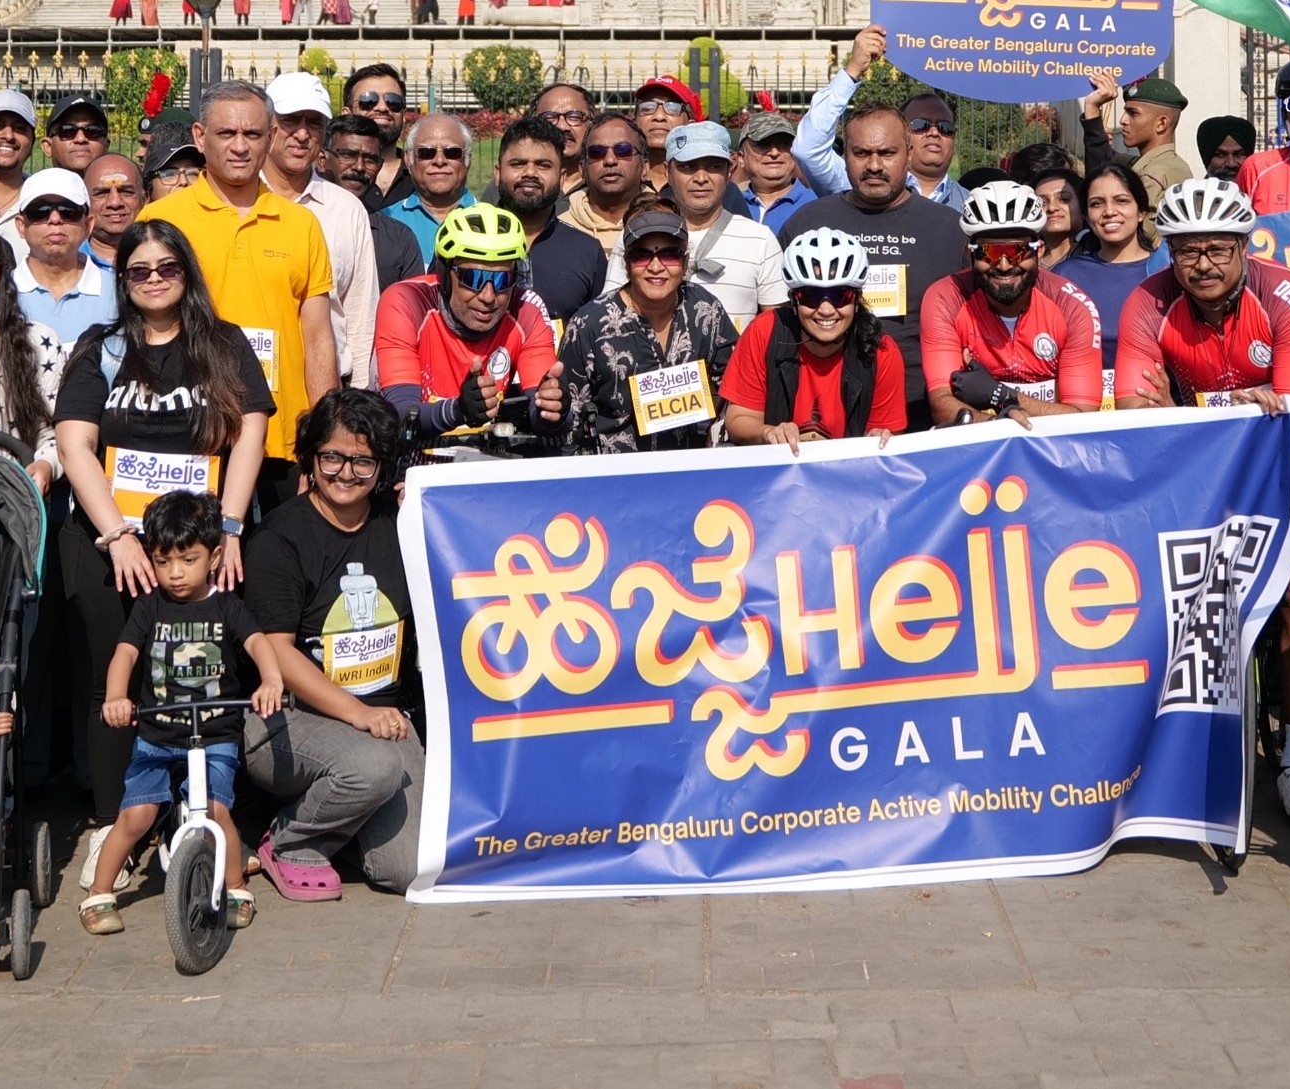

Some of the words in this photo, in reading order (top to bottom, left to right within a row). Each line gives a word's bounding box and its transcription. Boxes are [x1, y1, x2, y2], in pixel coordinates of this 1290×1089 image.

[1030, 13, 1116, 32] GALA
[896, 33, 926, 48] The
[930, 34, 991, 50] Greater
[994, 37, 1073, 54] Bengaluru
[1077, 40, 1156, 58] Corporate
[924, 57, 974, 72] Active
[978, 59, 1039, 77] Mobility
[887, 235, 900, 245] to
[901, 235, 916, 245] be
[863, 245, 879, 255] eal
[882, 245, 902, 256] 5G.
[249, 332, 272, 352] ejje
[667, 366, 699, 386] Hejje
[647, 394, 702, 420] ELCIA
[157, 459, 205, 485] Hejje
[776, 475, 1143, 694] Hejje
[155, 622, 224, 642] TROUBLE
[367, 630, 397, 651] Hejje
[167, 663, 227, 678] WARRIOR
[339, 670, 362, 683] WRI
[365, 663, 390, 678] India
[830, 712, 1046, 772] GALA
[474, 836, 518, 856] The
[523, 826, 612, 851] Greater
[617, 817, 734, 846] Bengaluru
[740, 801, 861, 835] Corporate
[868, 794, 942, 822] Active
[948, 786, 1043, 814] Mobility
